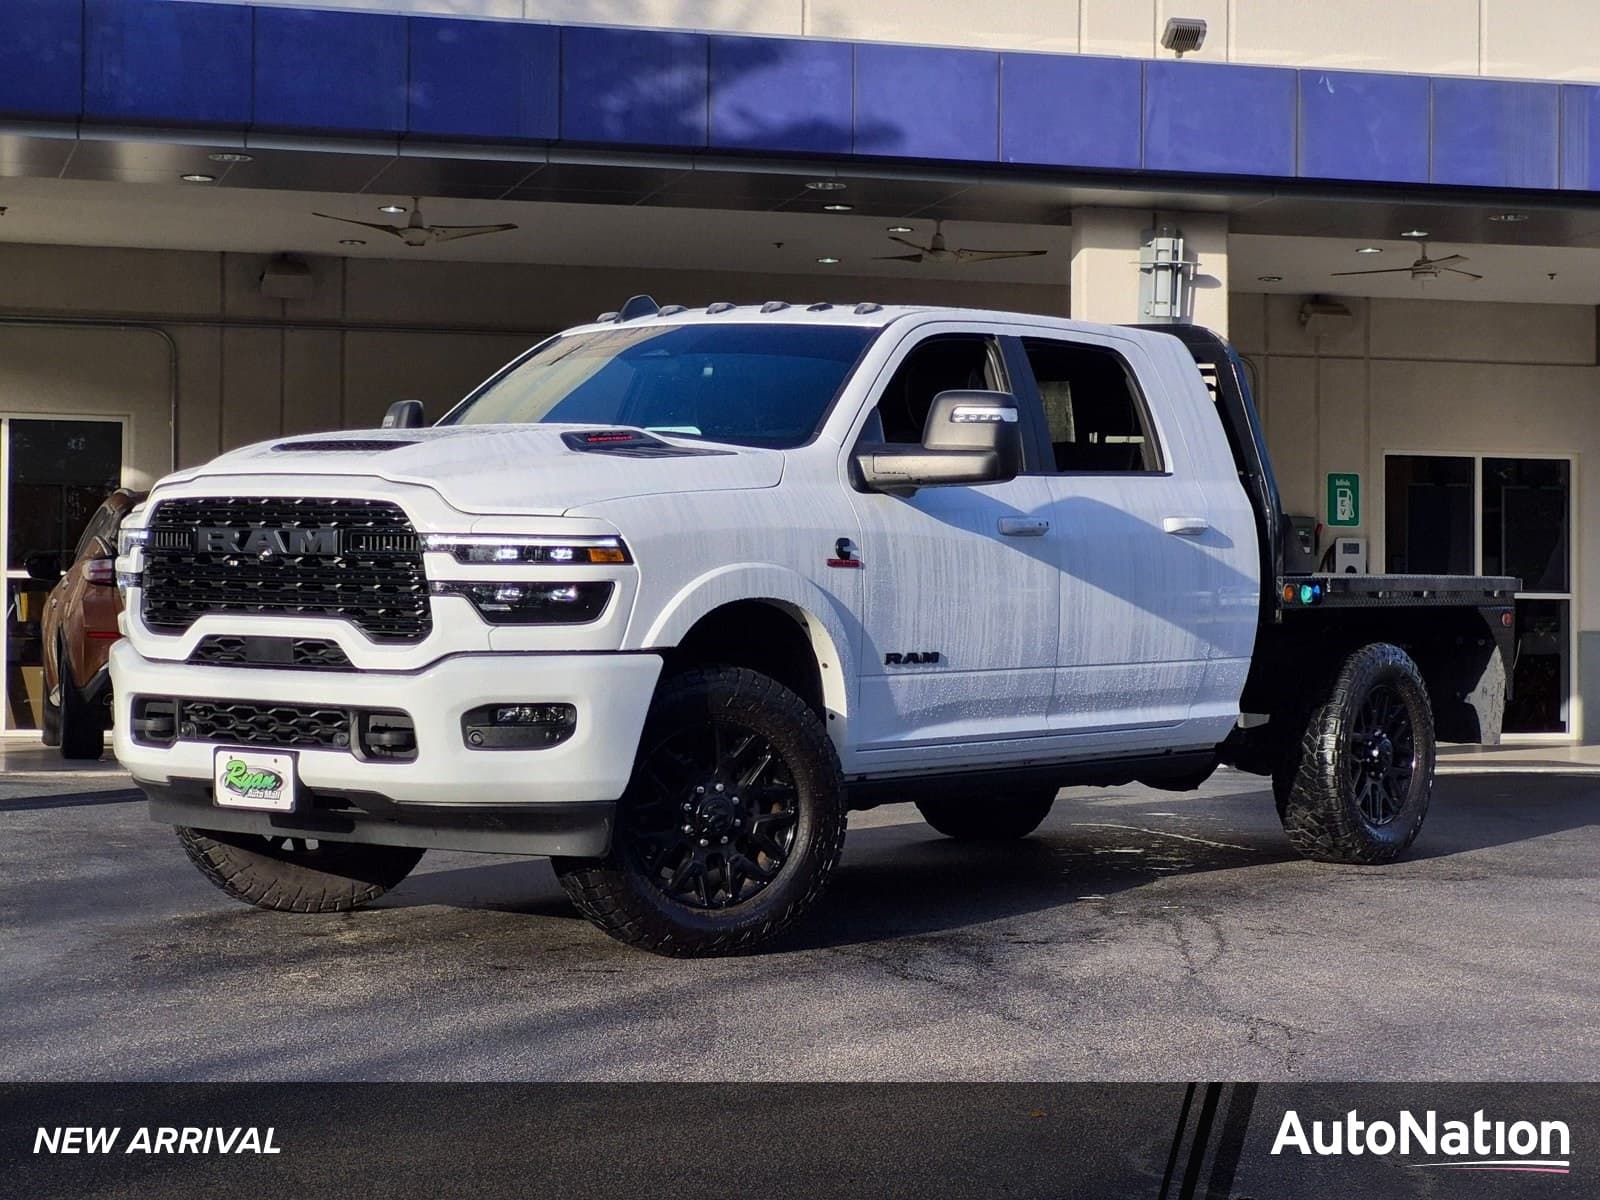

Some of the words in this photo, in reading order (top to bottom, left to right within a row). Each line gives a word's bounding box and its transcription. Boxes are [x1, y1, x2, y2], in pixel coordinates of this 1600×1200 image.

[197, 526, 338, 554] RAM
[885, 652, 940, 665] RAM
[224, 760, 277, 796] Ryan
